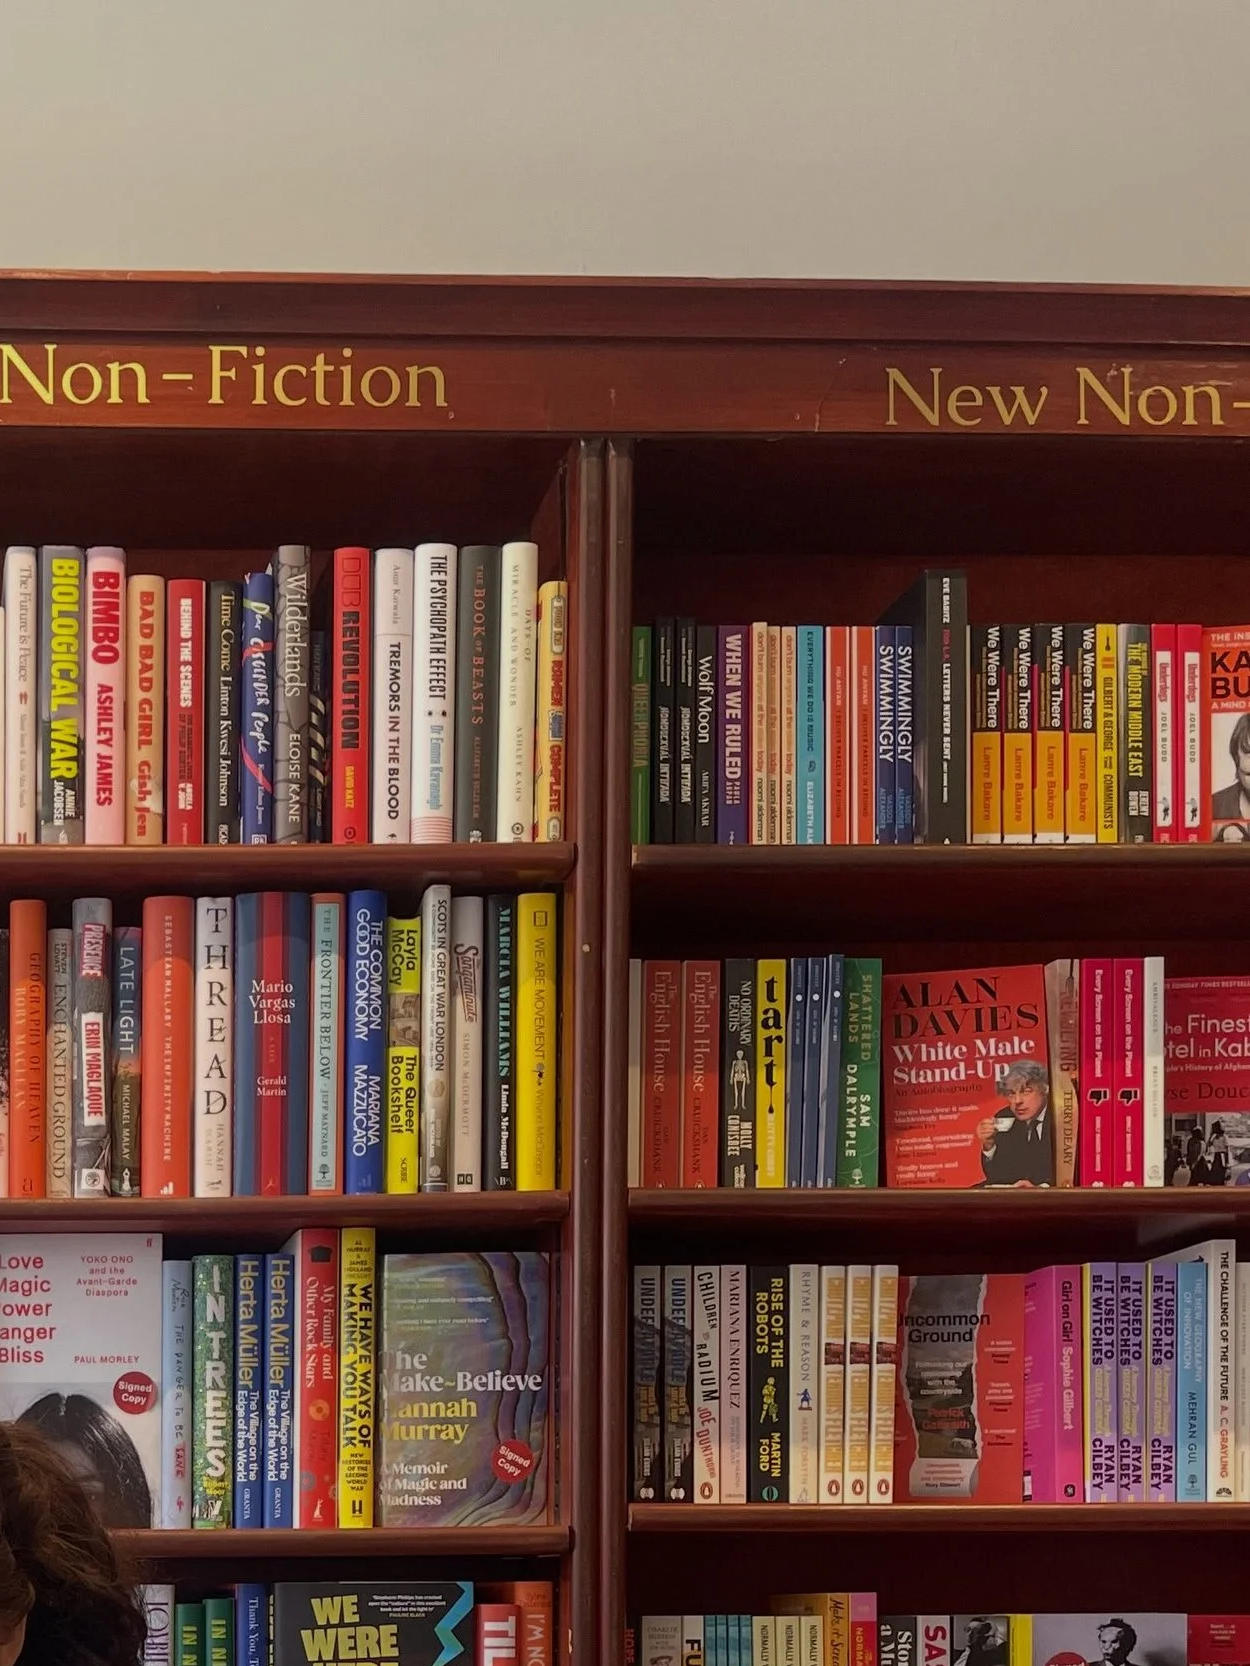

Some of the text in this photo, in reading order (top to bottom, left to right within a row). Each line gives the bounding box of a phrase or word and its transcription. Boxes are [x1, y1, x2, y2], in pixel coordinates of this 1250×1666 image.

[886, 367, 1047, 427] New
[50, 557, 81, 778] BIOLOGICAL WAR
[92, 571, 121, 806] BIMBO ASHLEY JAMES
[251, 980, 294, 993] Mario
[892, 975, 999, 1010] ALAN
[248, 996, 295, 1011] Vargas
[254, 1010, 291, 1024] Llosa
[760, 975, 782, 1086] tart
[892, 1004, 1040, 1039] DAVIES
[892, 1036, 1034, 1064] White Male
[257, 1077, 287, 1086] Gerald
[893, 1059, 1011, 1086] Stand-Up
[257, 1087, 287, 1097] Martin
[755, 1292, 769, 1354] ROBOTS
[771, 1278, 784, 1368] RISE OF THE
[118, 1380, 152, 1396] Signed
[121, 1393, 146, 1407] Copy
[311, 1596, 359, 1625] WE
[301, 1625, 399, 1661] WERE
